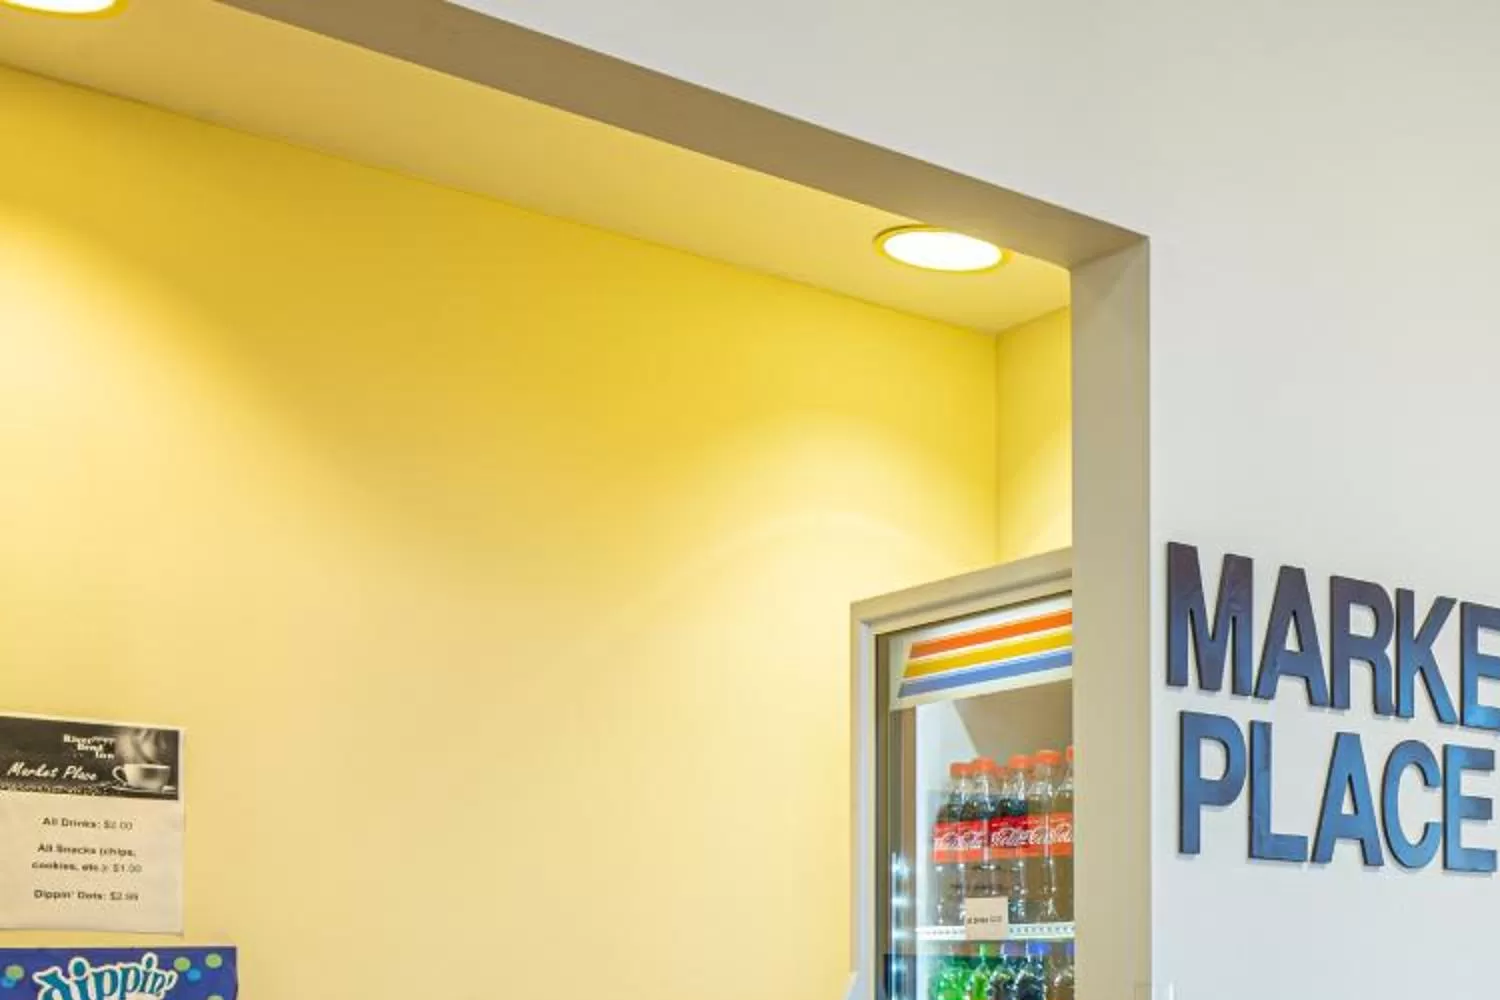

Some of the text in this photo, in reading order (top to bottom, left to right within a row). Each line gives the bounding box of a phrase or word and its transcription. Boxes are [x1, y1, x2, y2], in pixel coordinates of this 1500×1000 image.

[7, 761, 98, 782] Market Place
[1178, 710, 1498, 873] PLACE
[56, 844, 96, 856] Snacks
